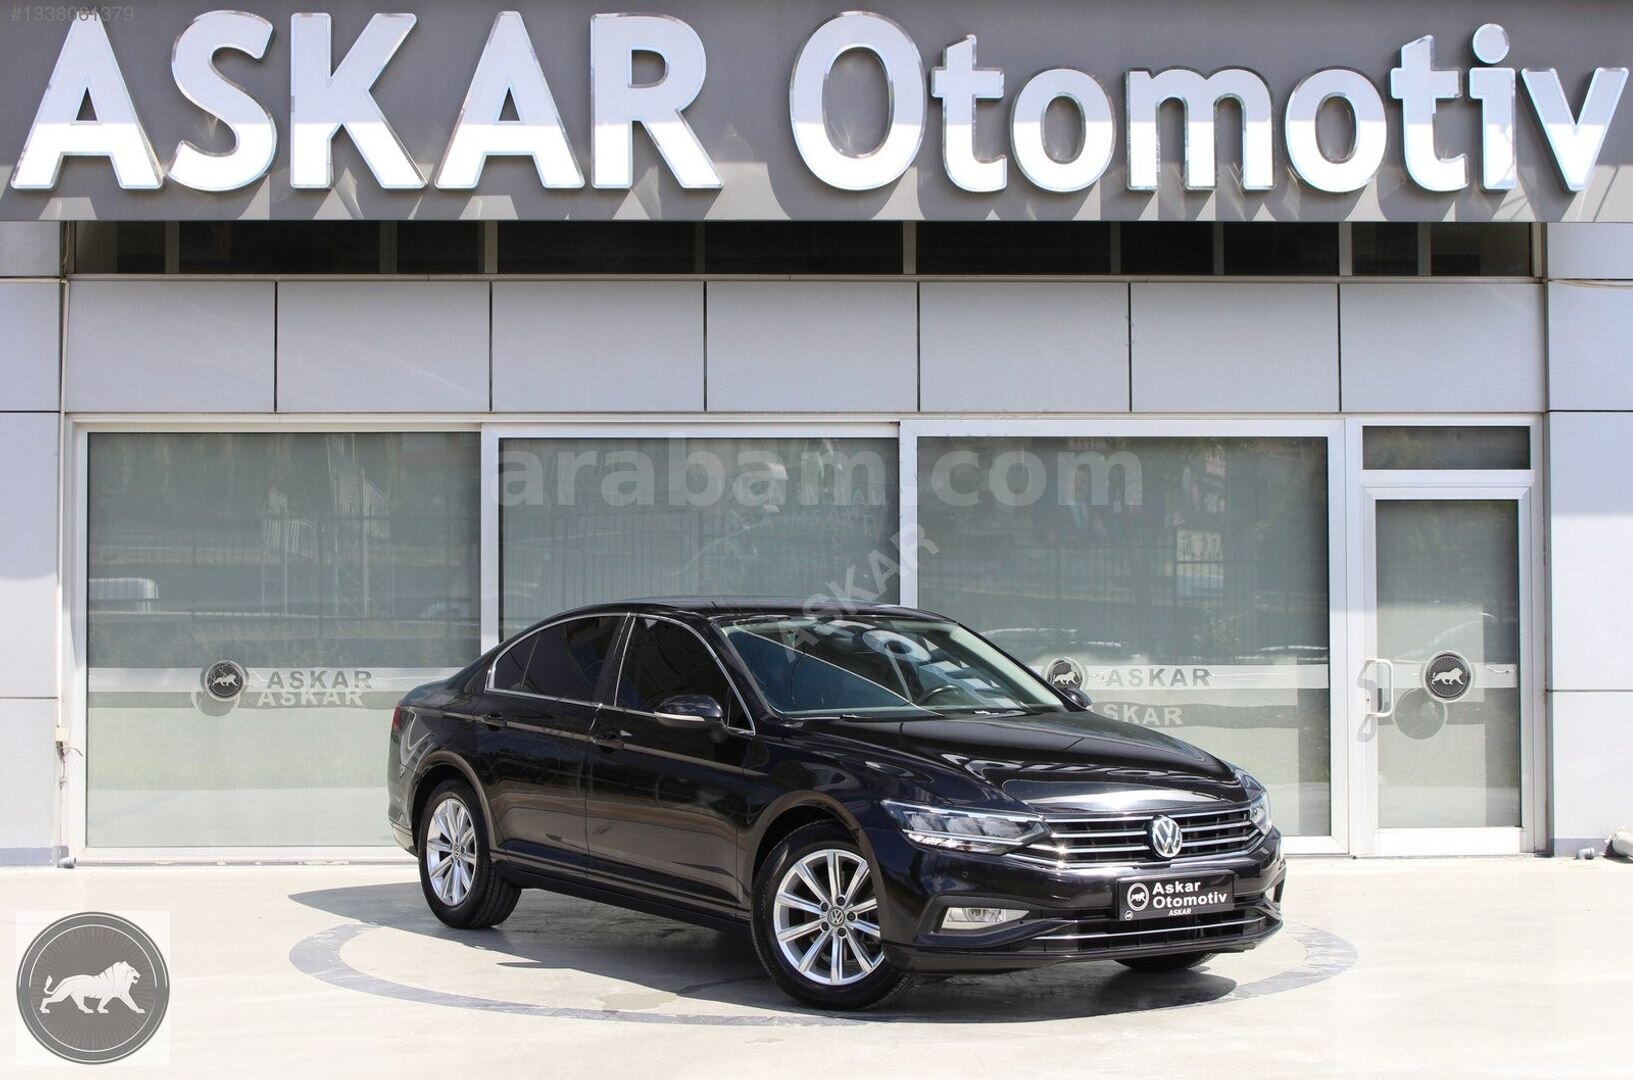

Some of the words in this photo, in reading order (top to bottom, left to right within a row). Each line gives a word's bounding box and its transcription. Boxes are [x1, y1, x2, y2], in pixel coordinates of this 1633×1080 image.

[11, 10, 723, 191] ASKAR
[789, 10, 1630, 194] Otomotiv
[266, 669, 373, 690] ASKAR
[1106, 668, 1211, 687] ASKAR
[1087, 704, 1183, 726] SKAR
[1152, 881, 1202, 896] Askar
[1152, 891, 1228, 909] Otomotiv
[1168, 908, 1192, 917] ASKAR
